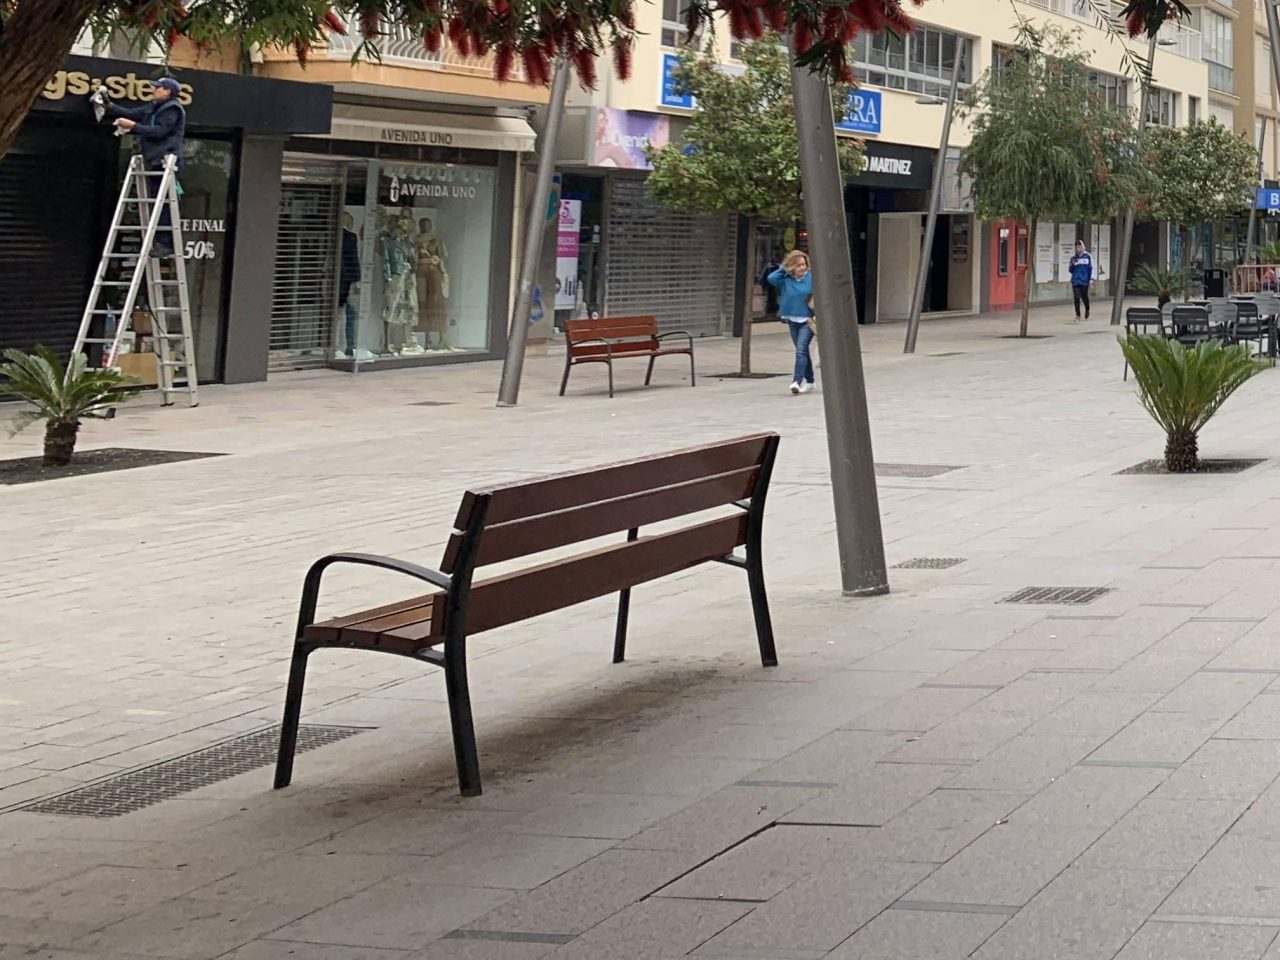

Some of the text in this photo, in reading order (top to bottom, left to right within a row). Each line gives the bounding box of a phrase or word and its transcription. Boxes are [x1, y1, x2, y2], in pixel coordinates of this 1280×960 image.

[381, 128, 453, 145] AVENIDA UNO
[869, 156, 912, 175] MARTINEZ
[400, 183, 476, 200] AVENIDA UNO
[192, 219, 226, 232] FINAL
[183, 240, 215, 260] 50%
